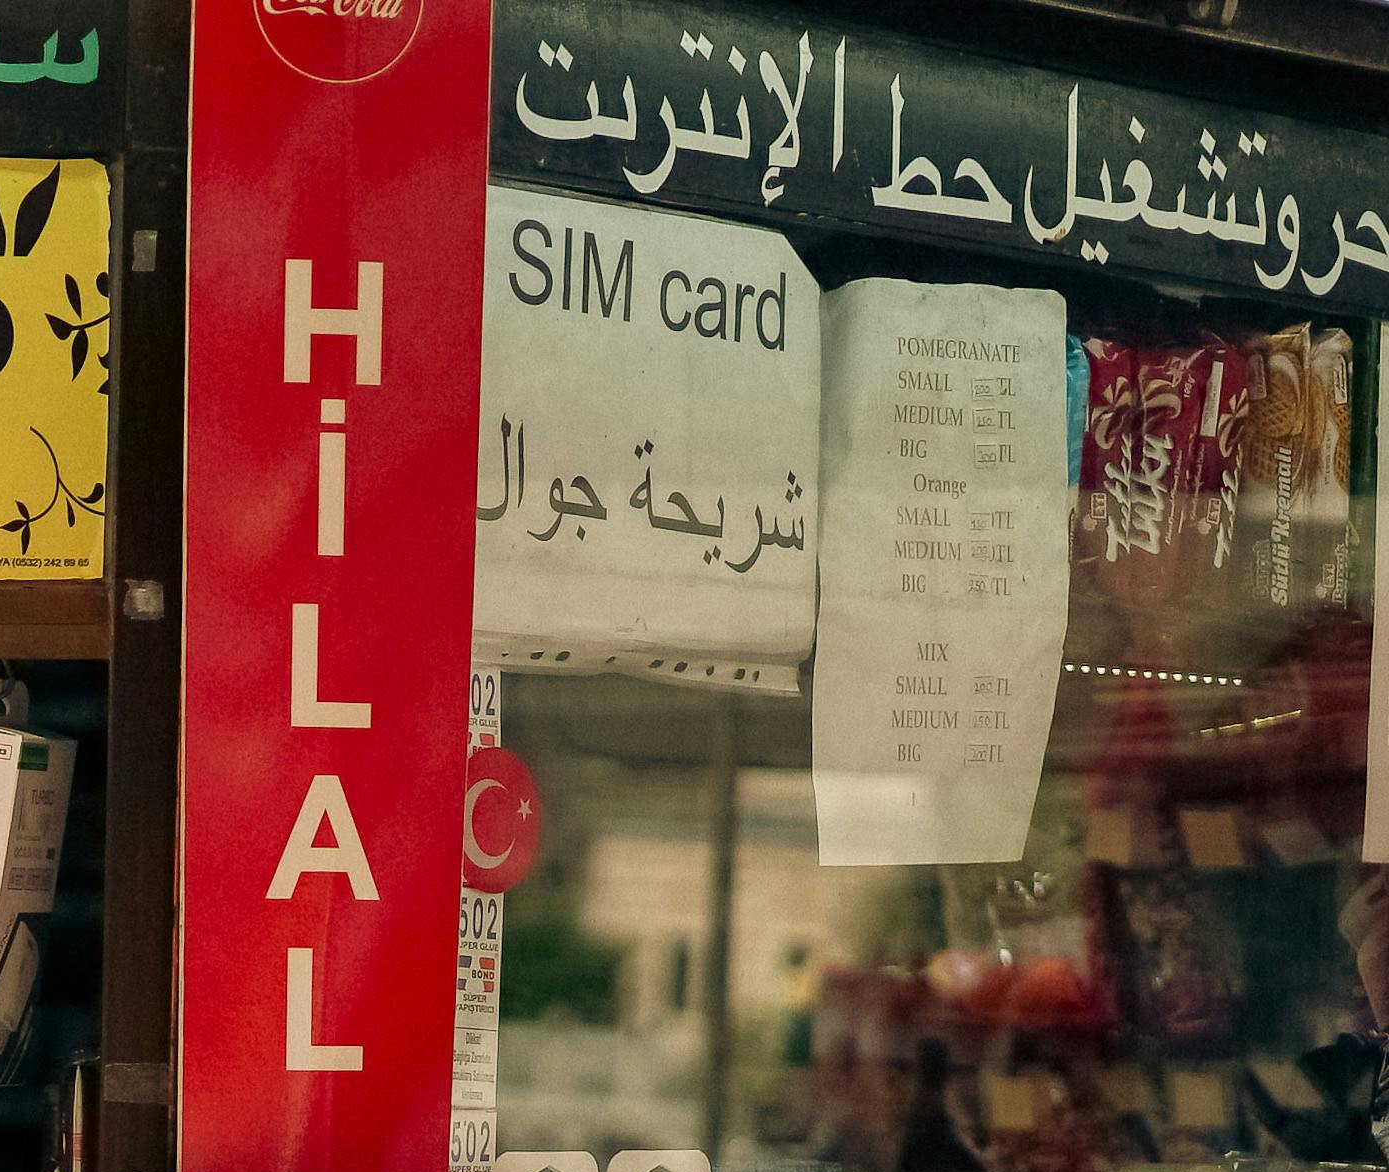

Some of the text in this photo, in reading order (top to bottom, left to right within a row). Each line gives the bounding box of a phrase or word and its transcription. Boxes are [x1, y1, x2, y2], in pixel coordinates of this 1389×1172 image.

[508, 218, 789, 353] SIM card
[897, 337, 1021, 364] POMEGRANATE
[898, 370, 952, 392] SMALL
[893, 404, 963, 426] MEDIUM
[899, 438, 927, 458] BIG
[913, 472, 967, 499] Orange
[629, 440, 808, 575] شريحة
[896, 506, 951, 527] SMALL
[893, 540, 962, 561] MEDIUM
[12, 558, 42, 568] (0532)
[901, 574, 926, 593] BIG
[917, 642, 949, 662] MIX
[895, 676, 947, 695] SMALL
[891, 709, 958, 729] MEDIUM
[897, 743, 921, 762] BIG
[471, 969, 495, 980] BOND
